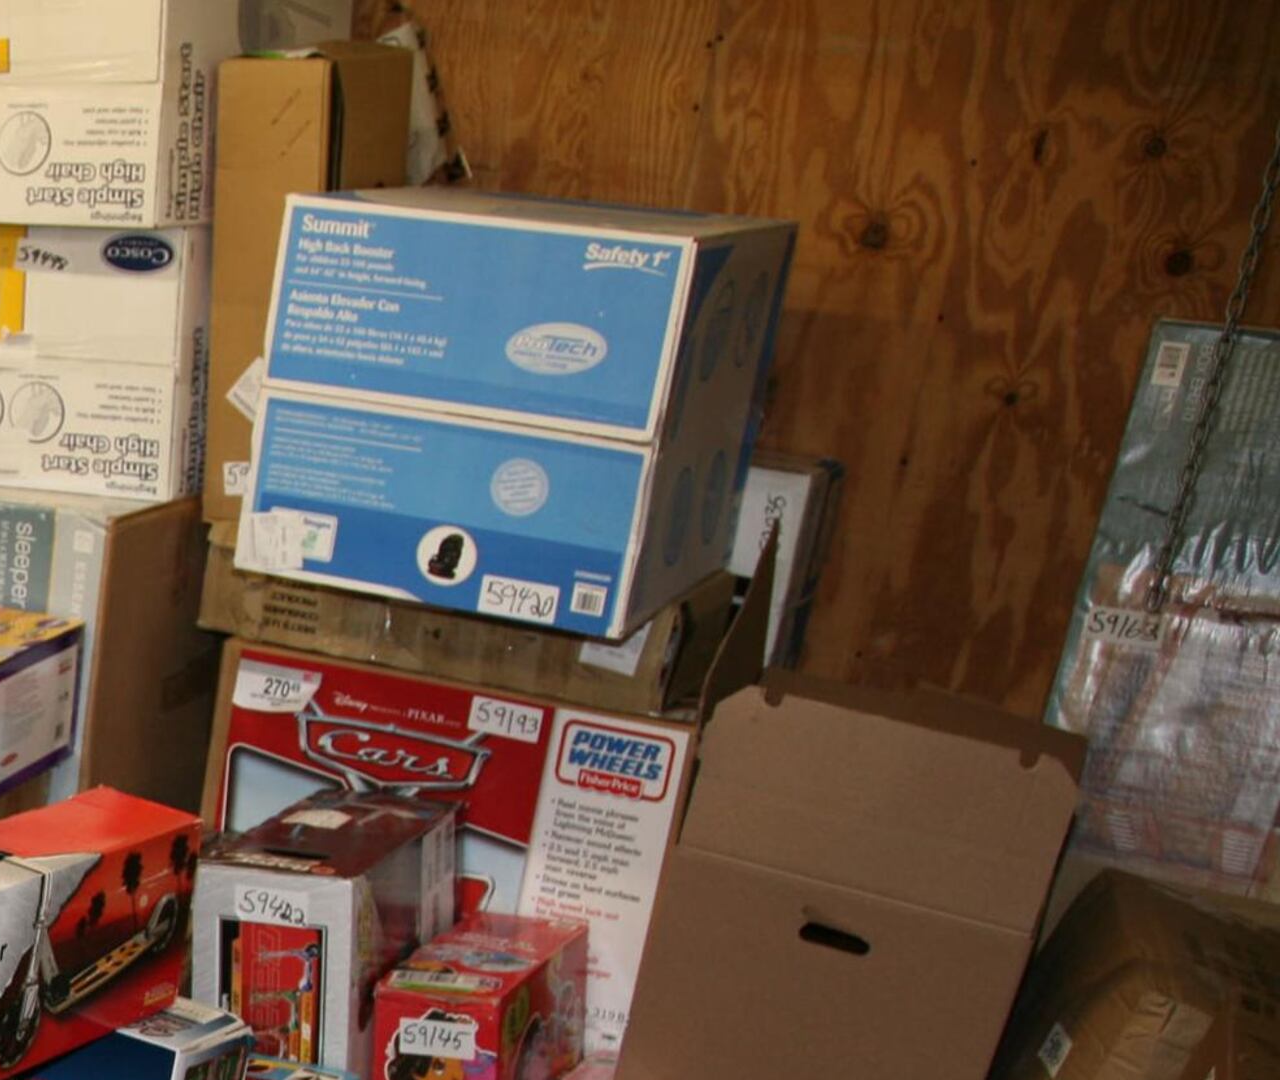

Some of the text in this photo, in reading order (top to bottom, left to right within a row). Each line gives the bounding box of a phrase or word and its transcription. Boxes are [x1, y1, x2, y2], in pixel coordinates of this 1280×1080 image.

[44, 160, 147, 183] High Chair
[25, 184, 145, 210] Simple Start
[301, 213, 372, 239] Summit
[105, 246, 172, 266] Cosco
[352, 243, 396, 260] Booster
[583, 242, 648, 267] Safety
[58, 432, 160, 458] High Chair
[40, 453, 159, 481] Simple Start
[9, 519, 36, 609] sleeper
[484, 578, 556, 618] 59420
[476, 701, 540, 736] 59193
[317, 727, 455, 780] Cars
[571, 729, 663, 762] POWER
[567, 748, 664, 782] WHEELS
[579, 771, 642, 795] Fisher-Price
